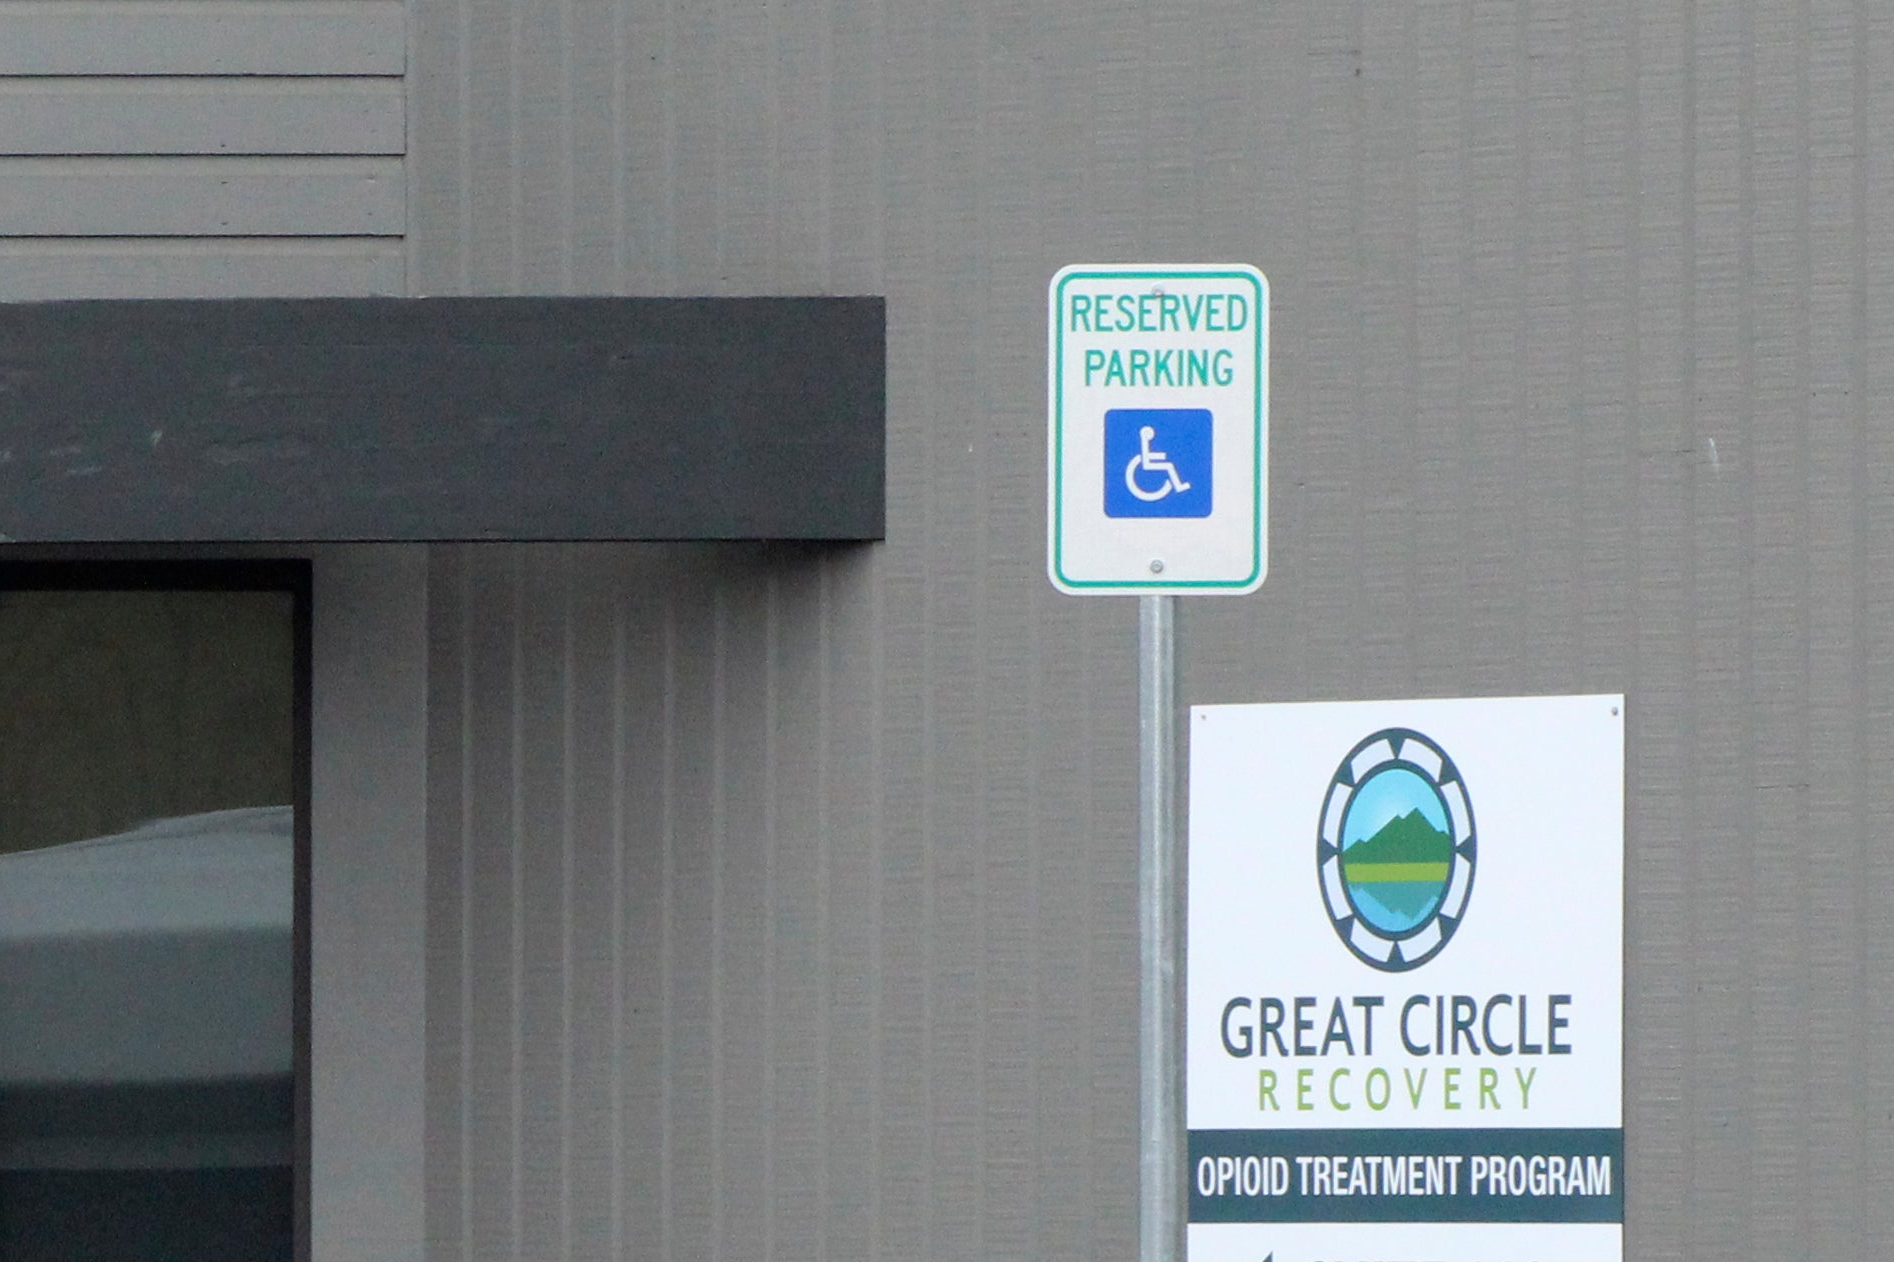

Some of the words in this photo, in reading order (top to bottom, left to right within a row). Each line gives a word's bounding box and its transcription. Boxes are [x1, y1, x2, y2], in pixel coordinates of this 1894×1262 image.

[1070, 293, 1249, 333] RESERVED
[1084, 348, 1234, 388] PARKING
[1219, 995, 1385, 1058] GREAT
[1398, 993, 1573, 1057] CIRCLE
[1257, 1066, 1538, 1112] RECOVERY
[1197, 1155, 1290, 1197] OPIOID
[1294, 1155, 1463, 1197] TREATMENT
[1469, 1155, 1611, 1197] PROGRAM
